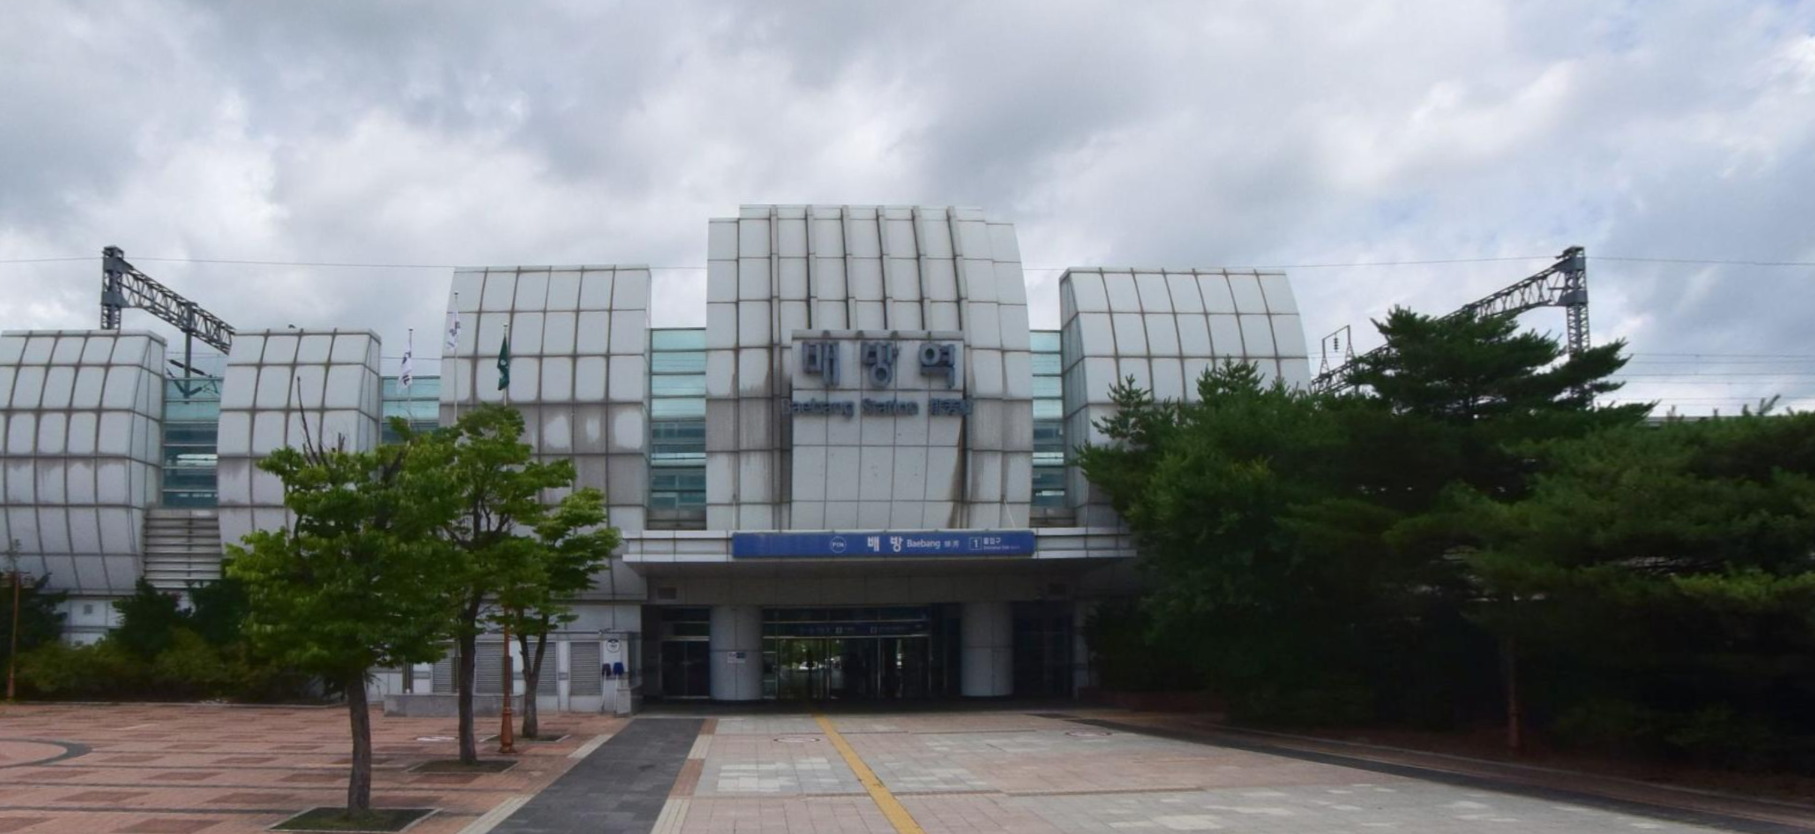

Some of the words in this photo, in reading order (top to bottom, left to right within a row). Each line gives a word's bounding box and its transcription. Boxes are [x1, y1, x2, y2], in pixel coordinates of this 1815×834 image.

[802, 341, 955, 388] 배방역
[781, 398, 854, 419] Baebang
[863, 398, 919, 415] Station
[907, 539, 941, 550] Baebang
